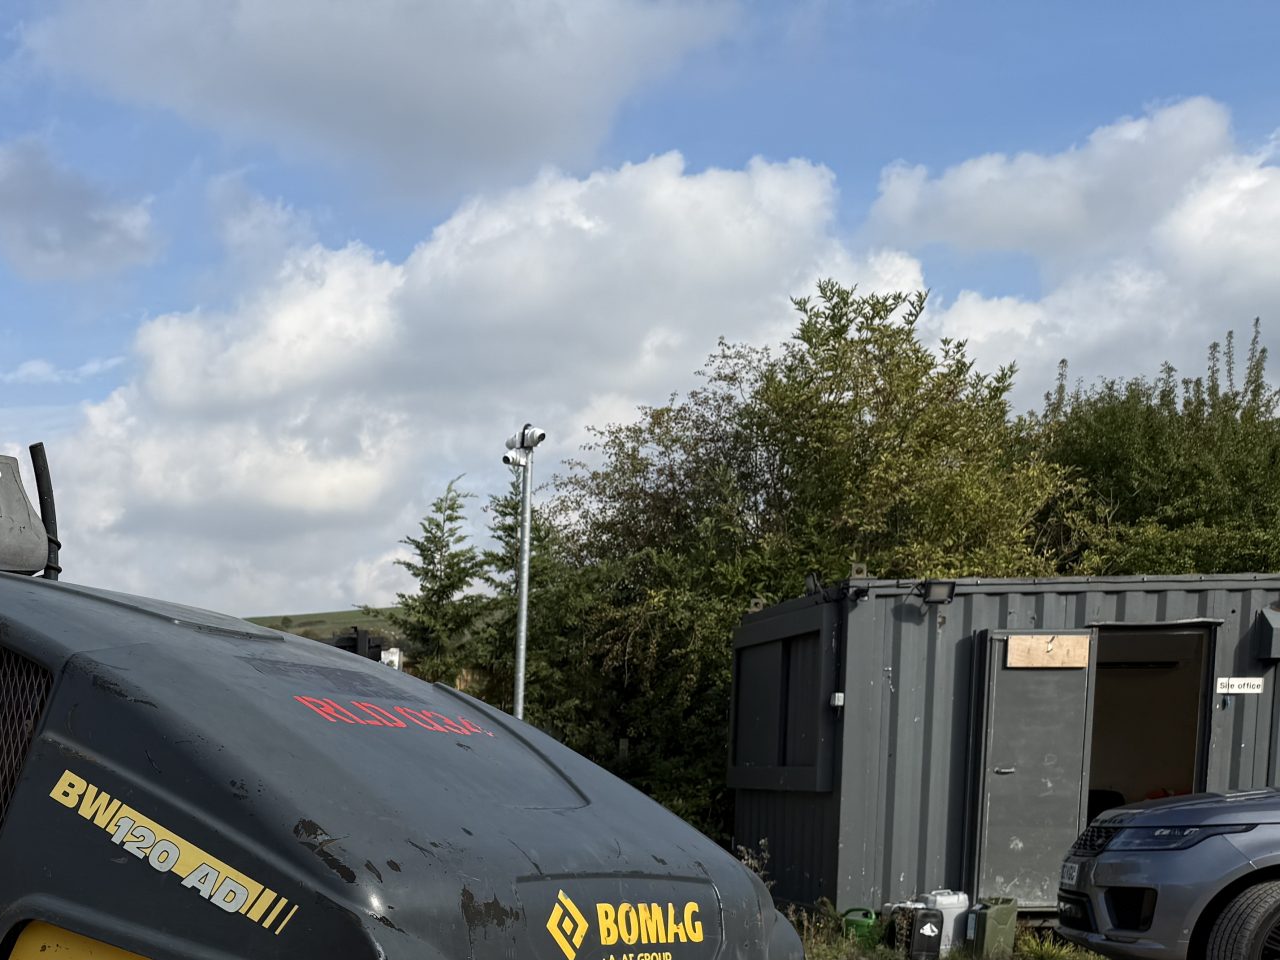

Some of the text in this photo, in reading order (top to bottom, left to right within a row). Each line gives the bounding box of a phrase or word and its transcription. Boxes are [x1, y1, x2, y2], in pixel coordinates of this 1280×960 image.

[1219, 681, 1261, 690] Site office
[293, 695, 408, 728] RLD
[180, 862, 240, 914] AD
[595, 901, 704, 946] BOMAG
